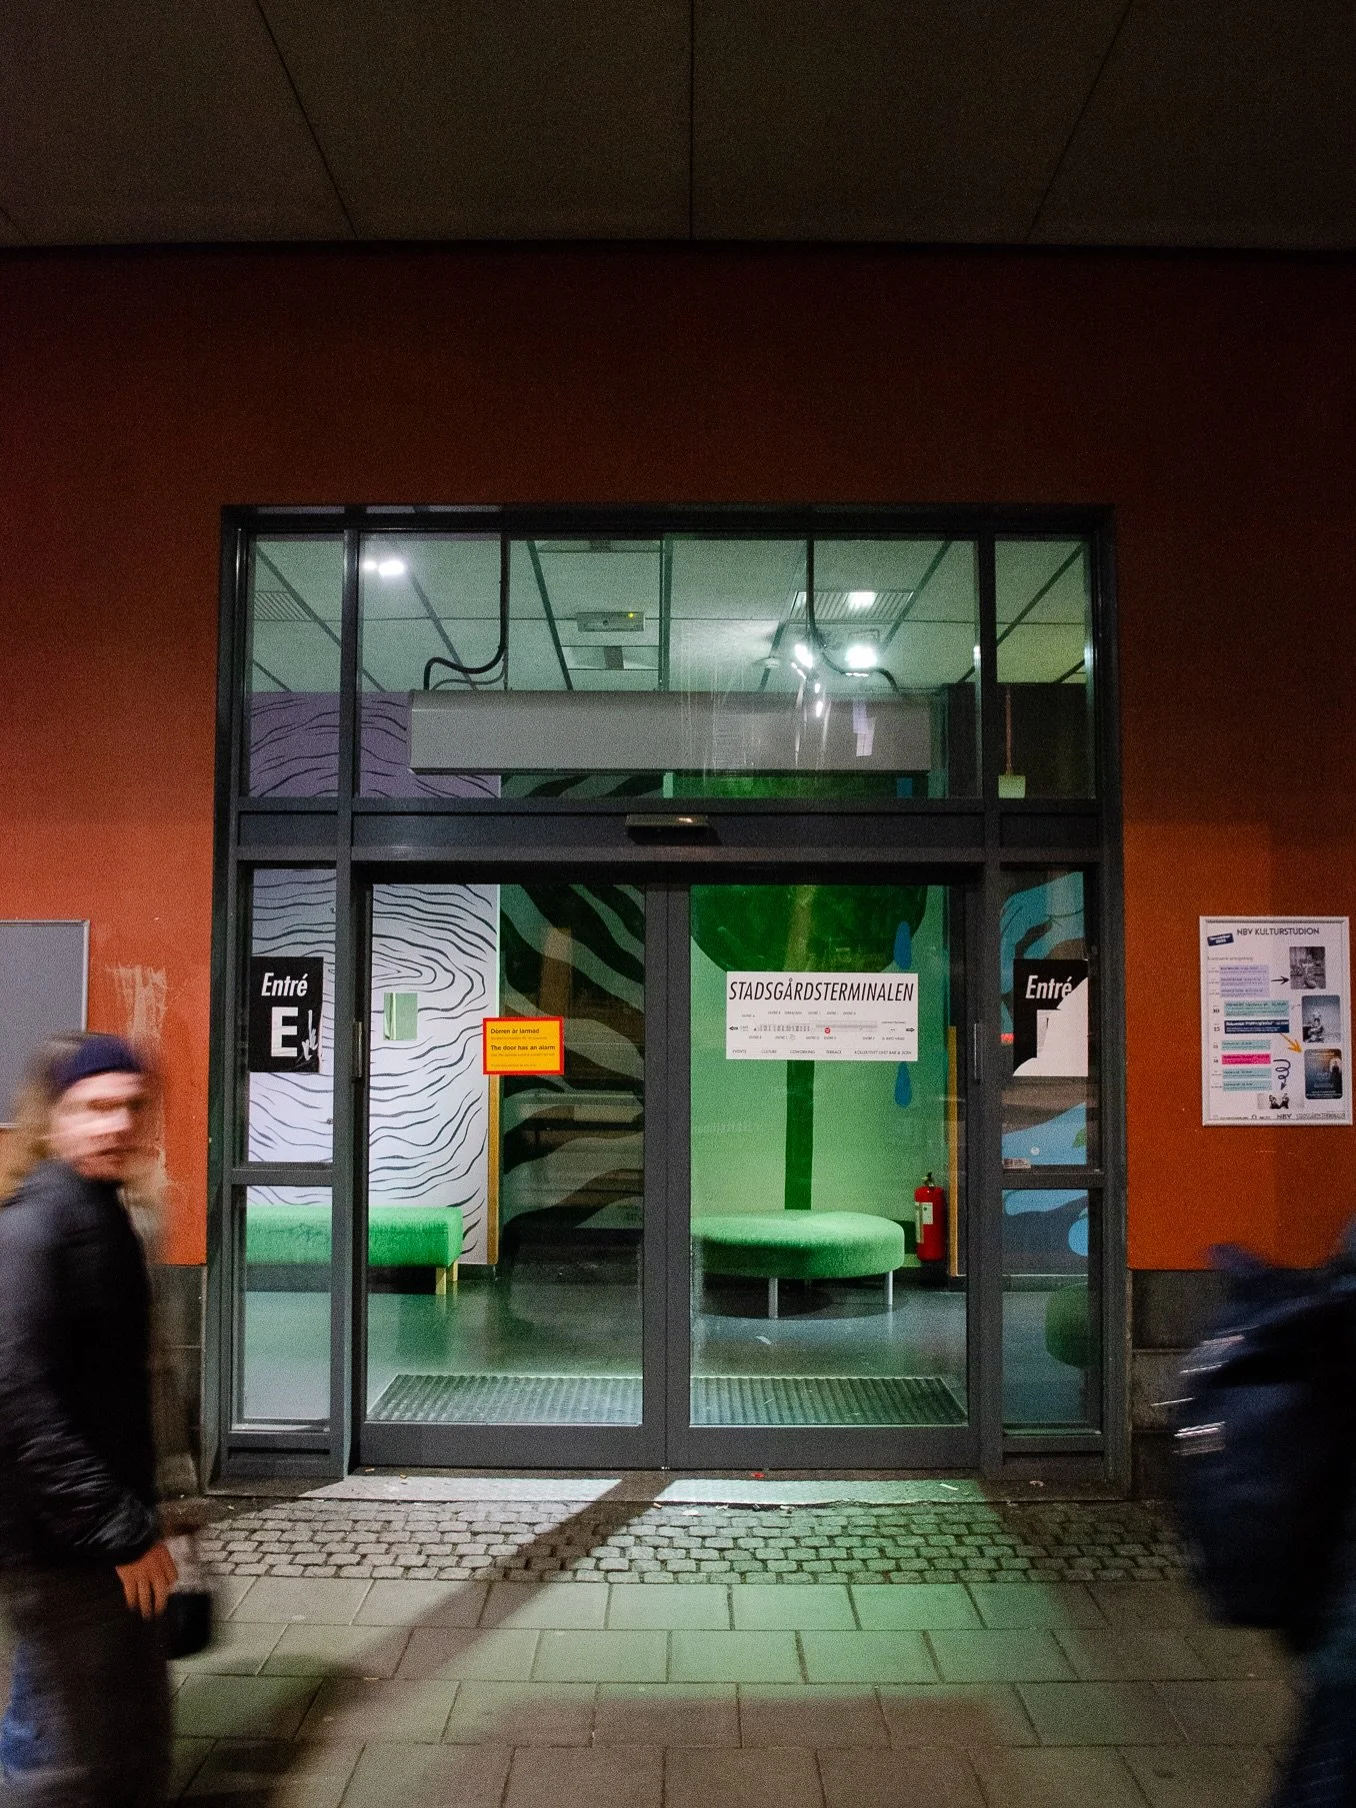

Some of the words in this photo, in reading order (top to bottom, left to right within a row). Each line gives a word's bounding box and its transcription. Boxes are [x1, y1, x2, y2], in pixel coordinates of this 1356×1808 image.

[1254, 927, 1320, 936] KULTURSTUDION
[261, 972, 309, 997] Entré
[728, 977, 914, 1002] STADSGÅRDSTERMINALEN
[1025, 974, 1073, 999] Entré
[270, 1006, 299, 1057] E
